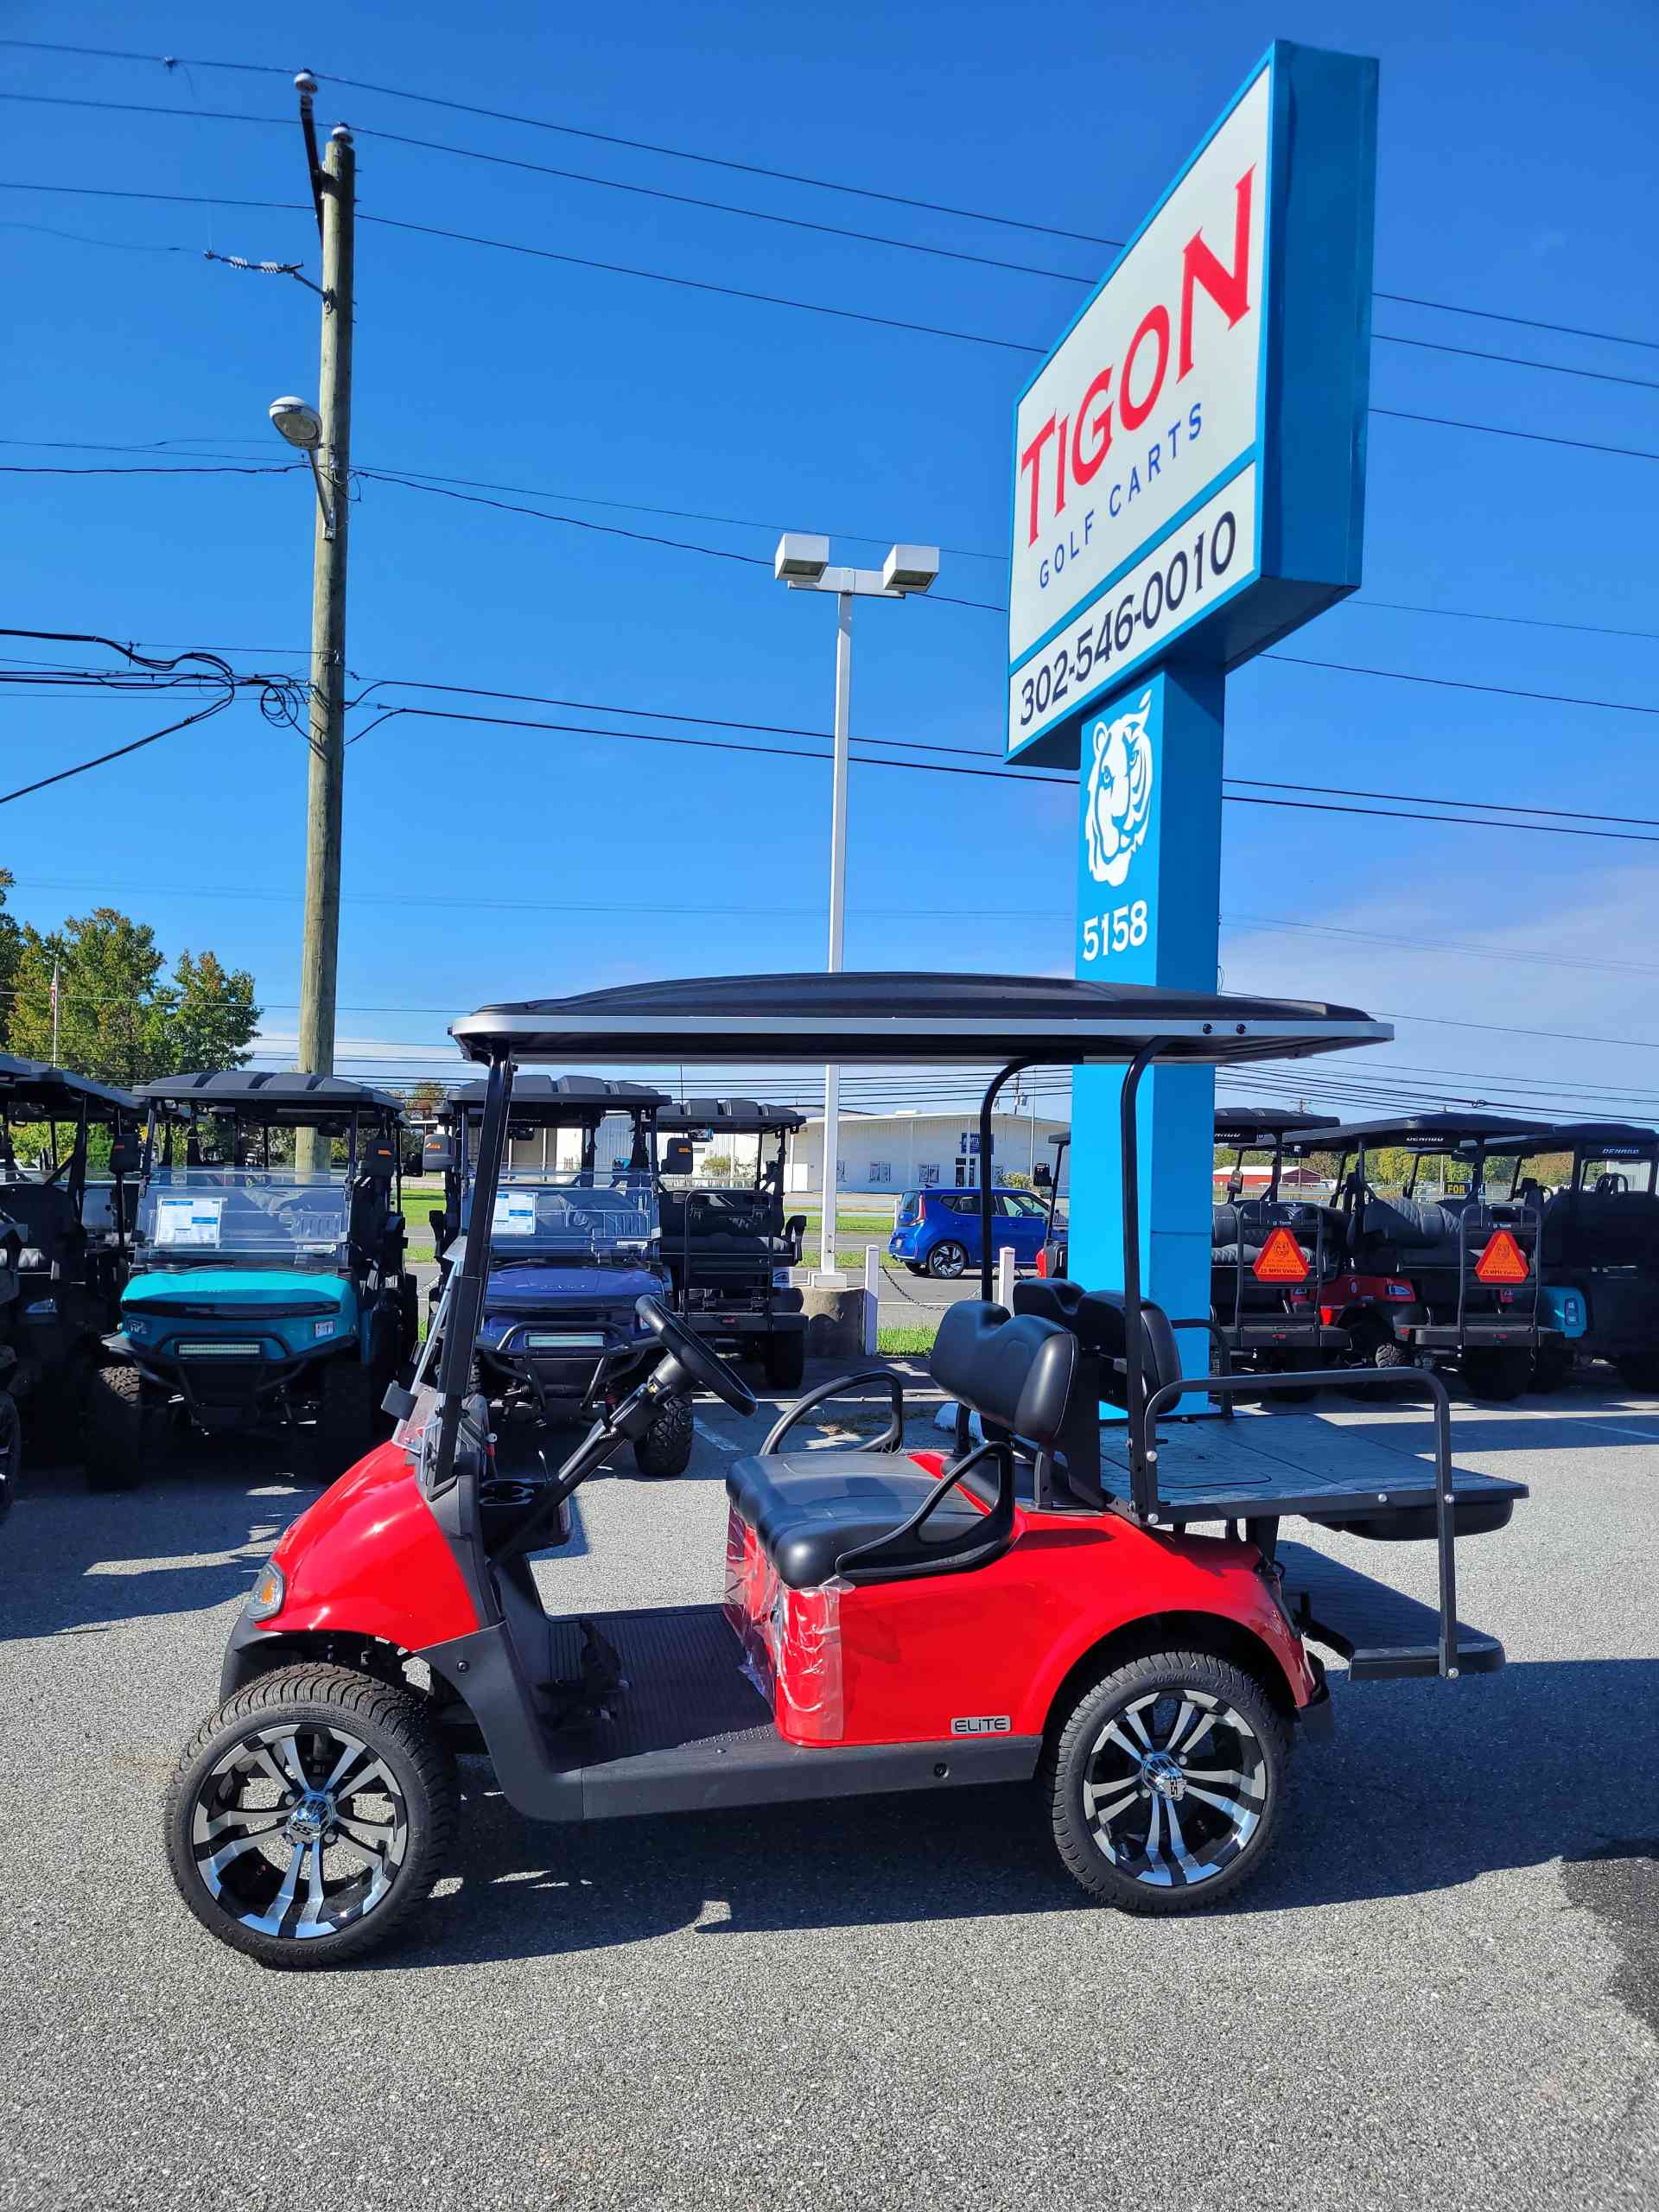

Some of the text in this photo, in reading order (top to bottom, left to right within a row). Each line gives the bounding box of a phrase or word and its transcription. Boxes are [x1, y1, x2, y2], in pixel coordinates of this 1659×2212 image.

[1020, 162, 1256, 548] TIGON
[1039, 403, 1202, 589] GOLF CARTS
[1020, 511, 1236, 727] 302-546-0010
[1083, 899, 1147, 962] 5158
[1447, 1184, 1465, 1193] FOR
